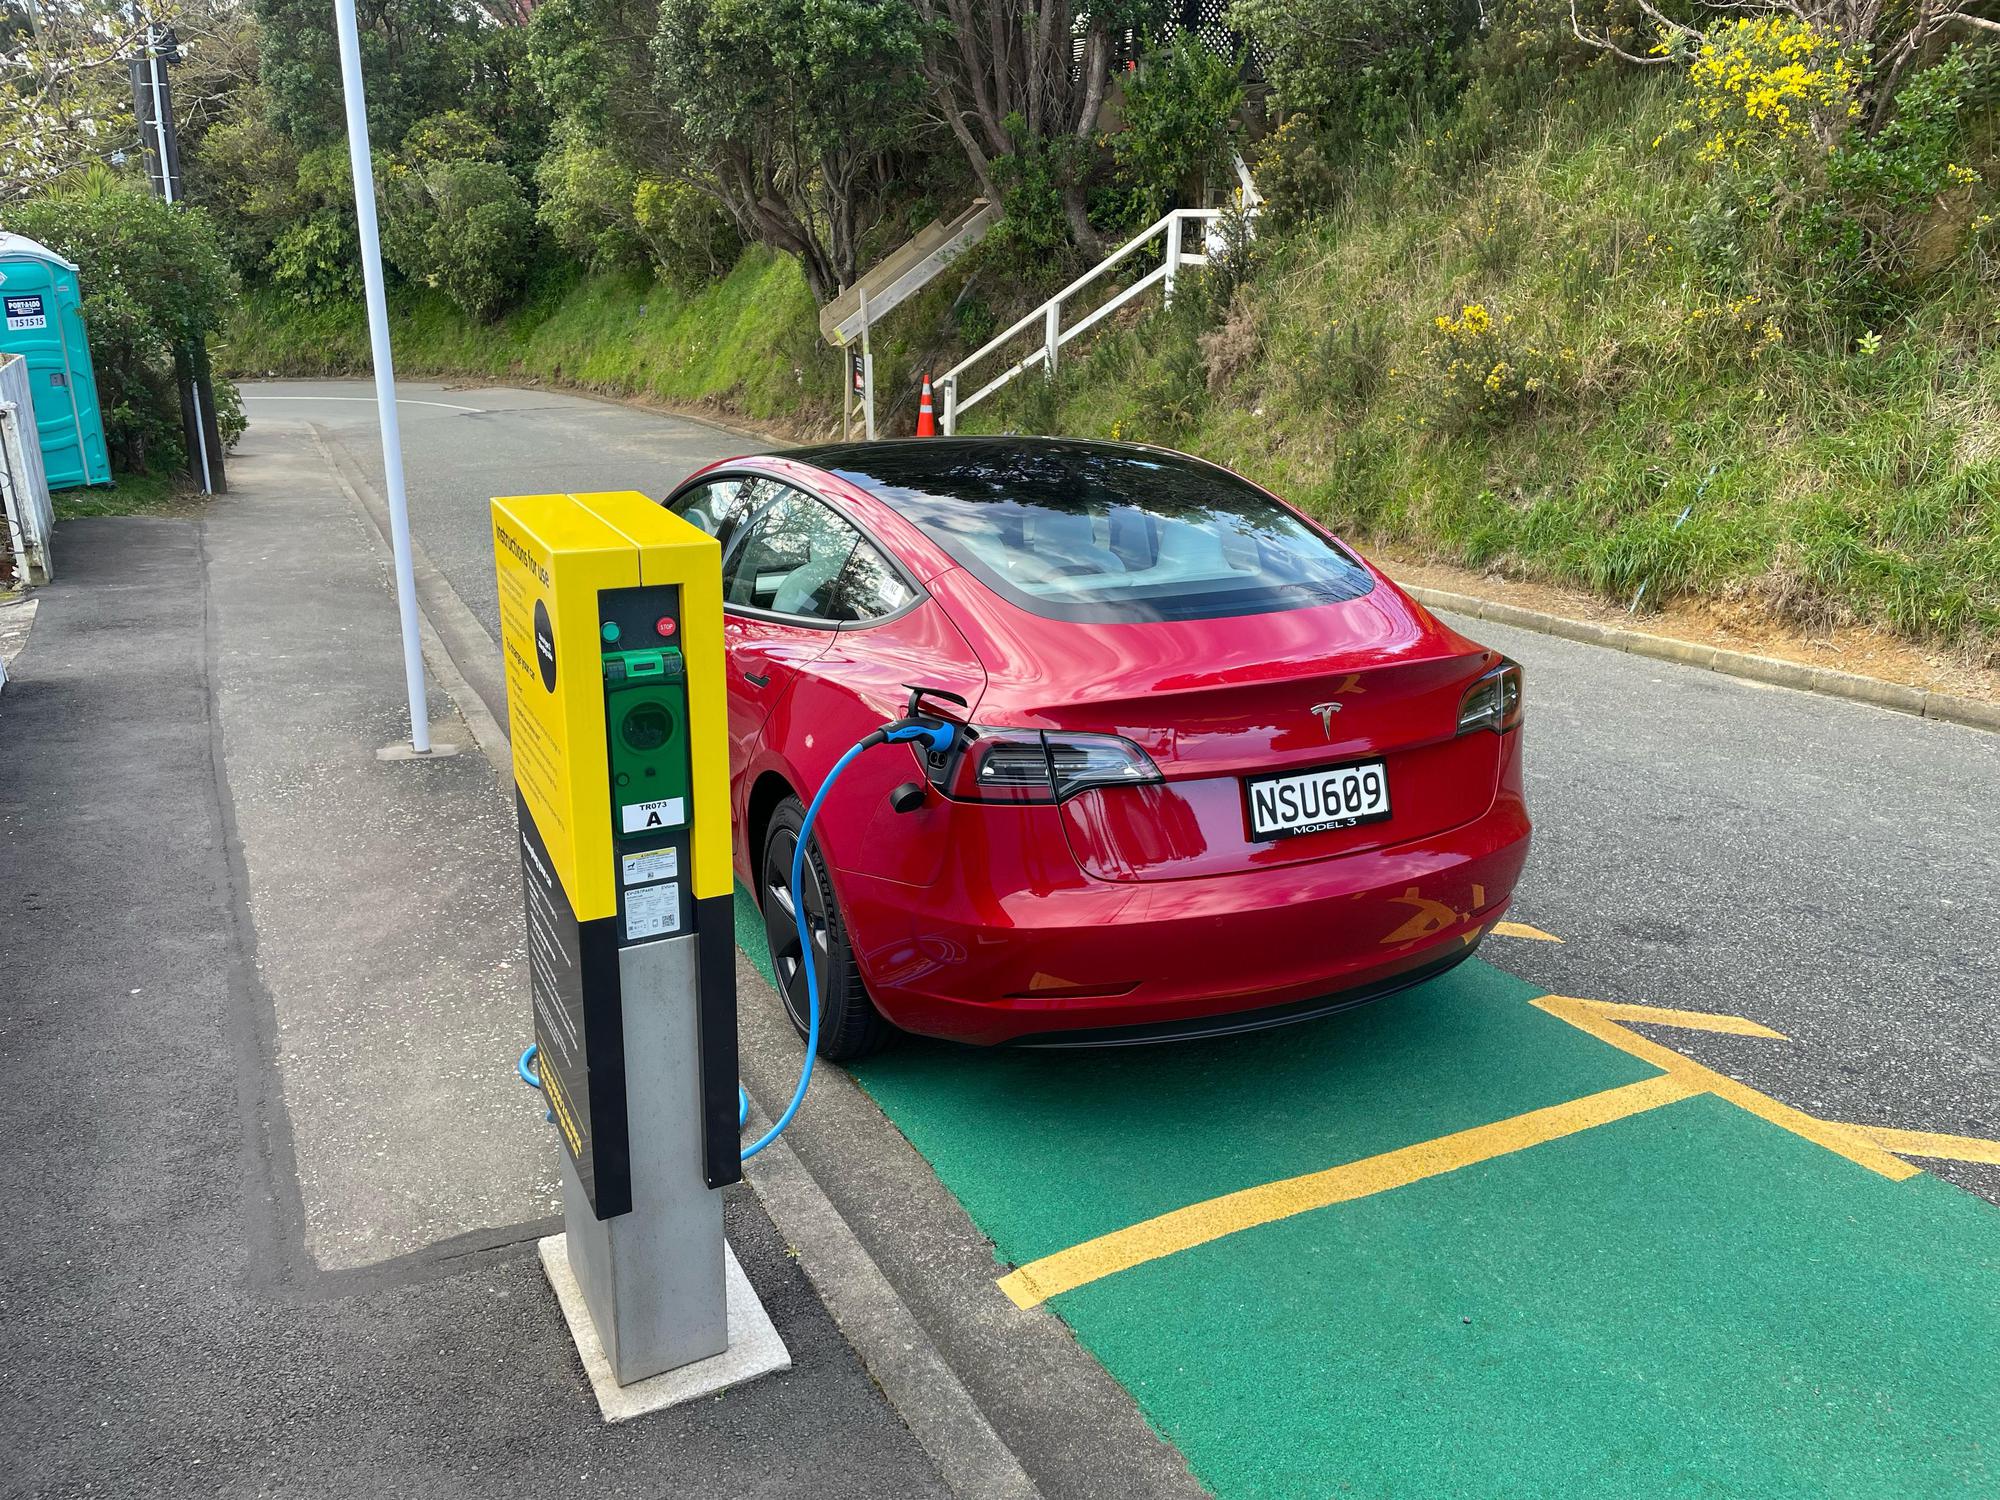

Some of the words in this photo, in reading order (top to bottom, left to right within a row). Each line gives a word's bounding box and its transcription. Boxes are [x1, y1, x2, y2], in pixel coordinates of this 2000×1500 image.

[495, 520, 528, 568] Instructions
[527, 549, 537, 577] for
[538, 563, 549, 589] use
[660, 623, 673, 631] STOP
[639, 801, 668, 811] TR073
[1256, 772, 1381, 827] NSU609
[646, 811, 662, 827] A
[1293, 821, 1343, 835] MODEL
[1347, 818, 1357, 827] 3
